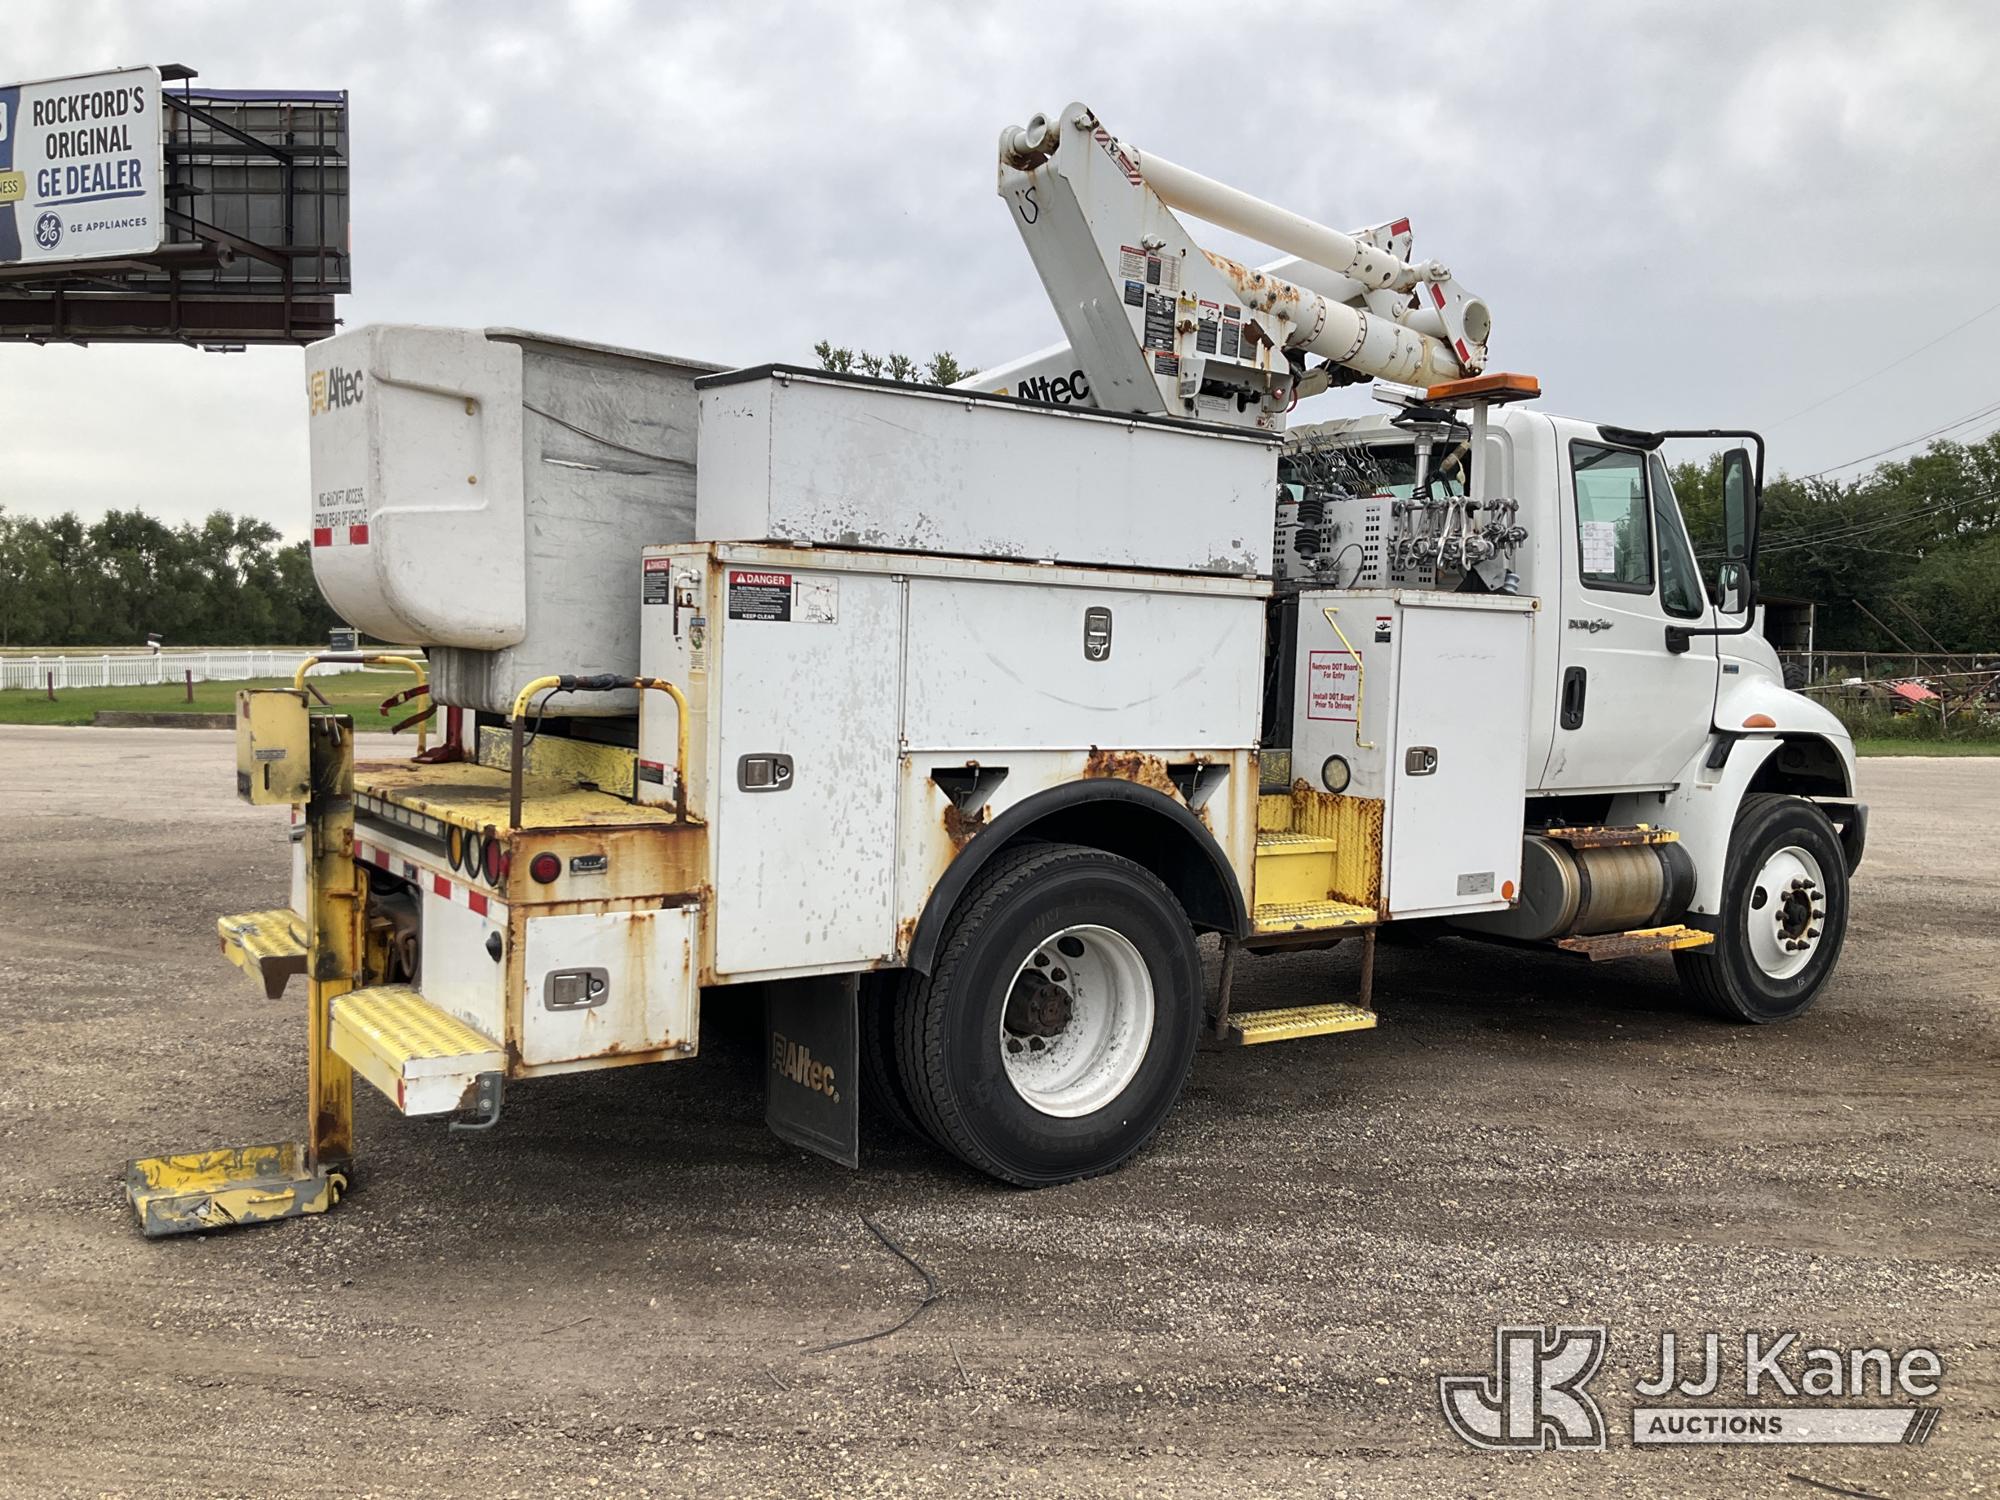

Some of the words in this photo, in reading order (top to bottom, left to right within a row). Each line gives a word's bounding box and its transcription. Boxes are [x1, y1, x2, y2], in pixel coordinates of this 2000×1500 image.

[33, 86, 145, 127] ROCKFORD'S
[46, 124, 132, 160] ORIGINAL
[37, 167, 62, 198] GE
[66, 158, 143, 195] DEALER
[70, 224, 83, 233] GE
[86, 217, 148, 232] APPLIANCES
[327, 366, 364, 411] Altec
[746, 574, 786, 585] DANGER
[1312, 662, 1331, 671] Remove
[1343, 663, 1358, 671] Board
[1323, 671, 1331, 679] For
[1332, 671, 1345, 680] Entry
[1334, 701, 1352, 711] Driving
